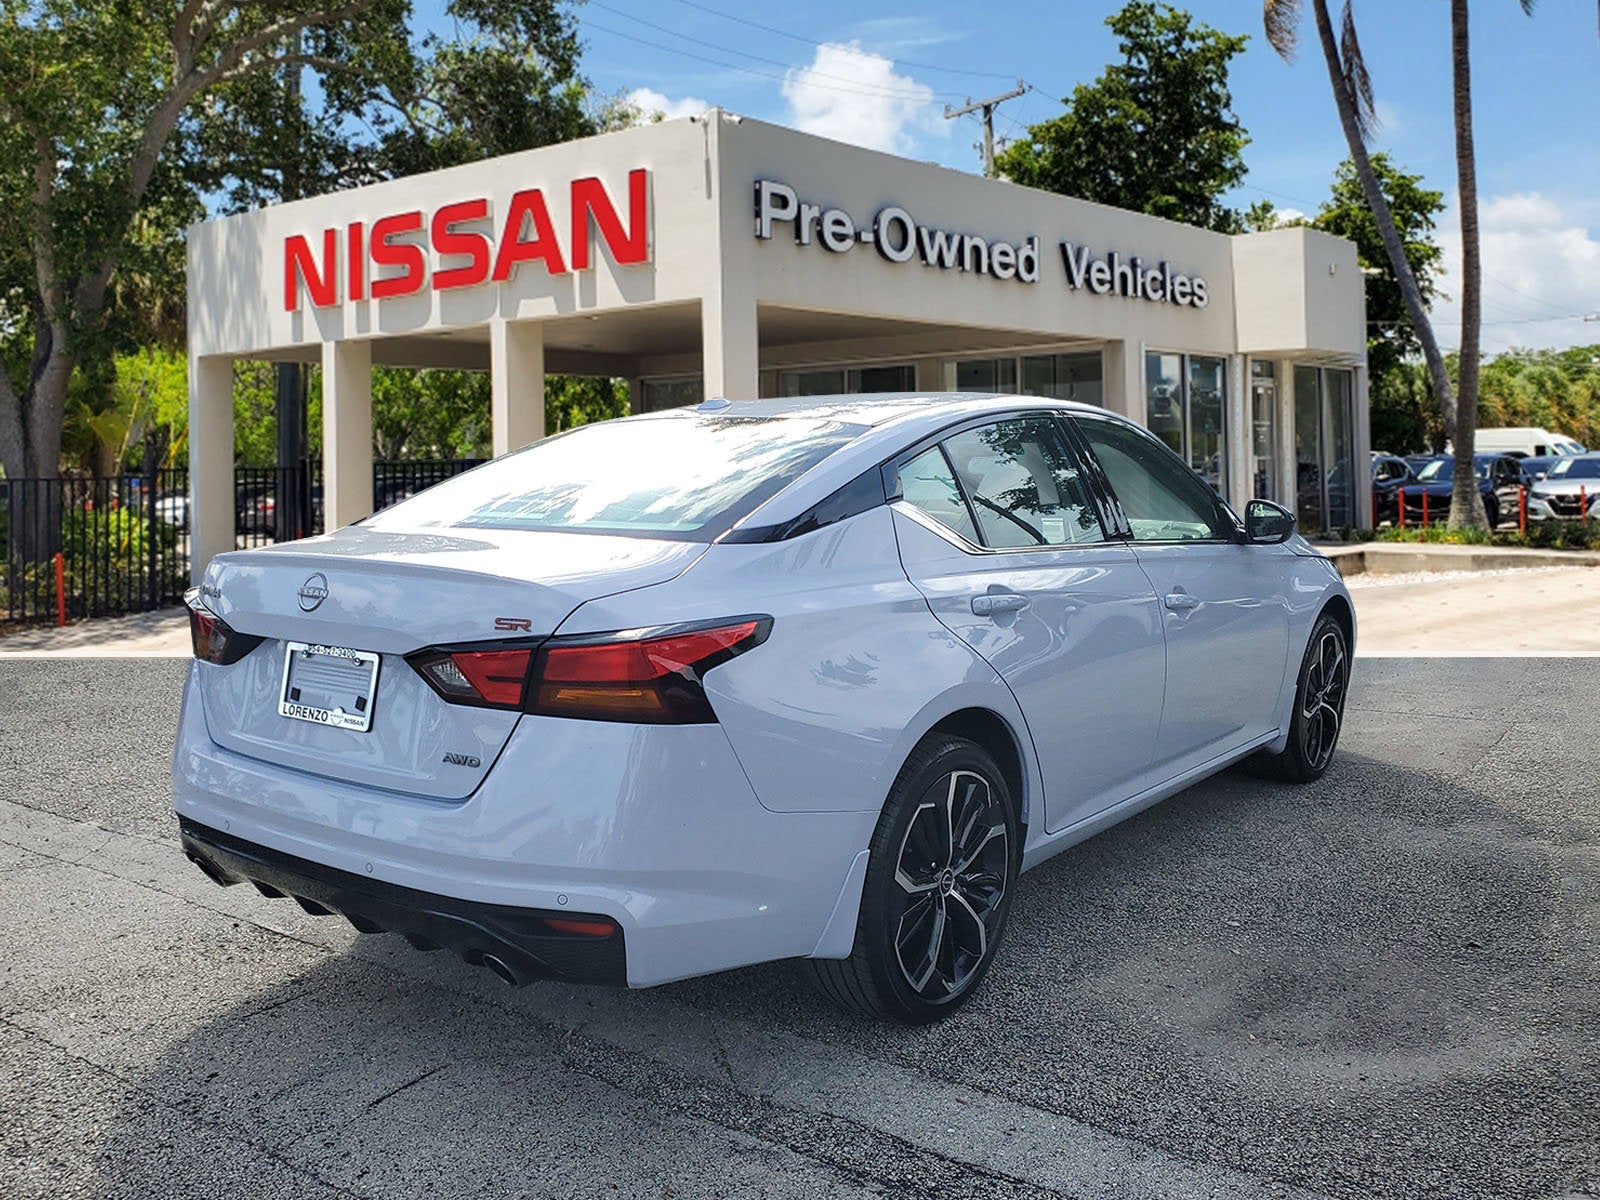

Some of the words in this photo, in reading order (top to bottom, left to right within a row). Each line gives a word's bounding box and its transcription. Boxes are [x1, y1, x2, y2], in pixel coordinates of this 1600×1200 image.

[285, 168, 648, 311] NISSAN
[754, 179, 1039, 283] Pre-Owned
[1060, 241, 1208, 308] Vehicles
[494, 617, 532, 632] SR
[282, 703, 329, 722] LORENZO
[344, 717, 364, 727] NISSAN
[442, 752, 481, 768] AWD
